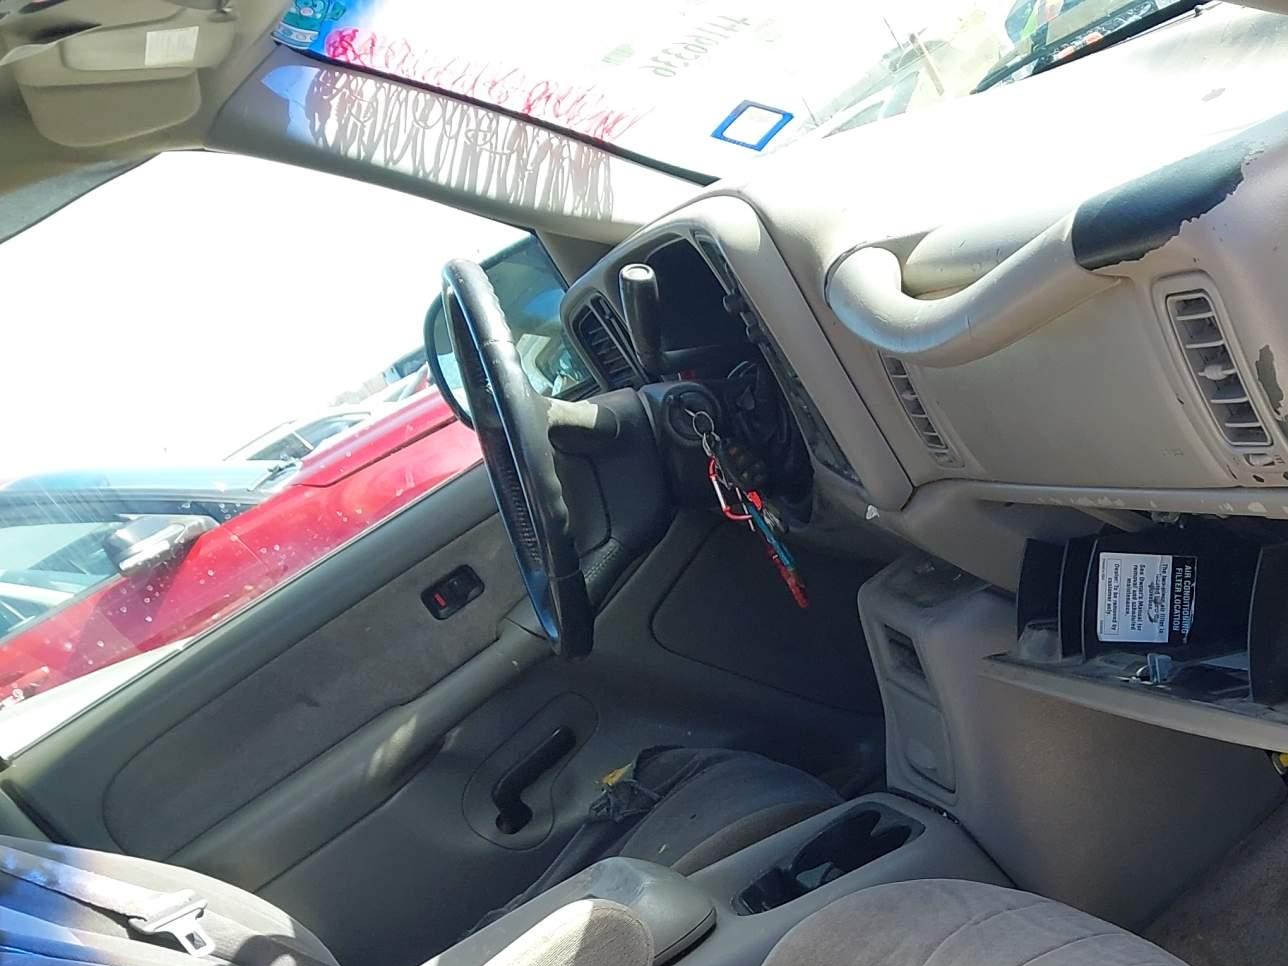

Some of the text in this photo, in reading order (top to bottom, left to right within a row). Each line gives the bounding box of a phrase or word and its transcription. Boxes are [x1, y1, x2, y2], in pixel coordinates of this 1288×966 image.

[1173, 568, 1183, 631] FILTER LOCATION
[1181, 565, 1192, 634] AIR CONDITIONING
